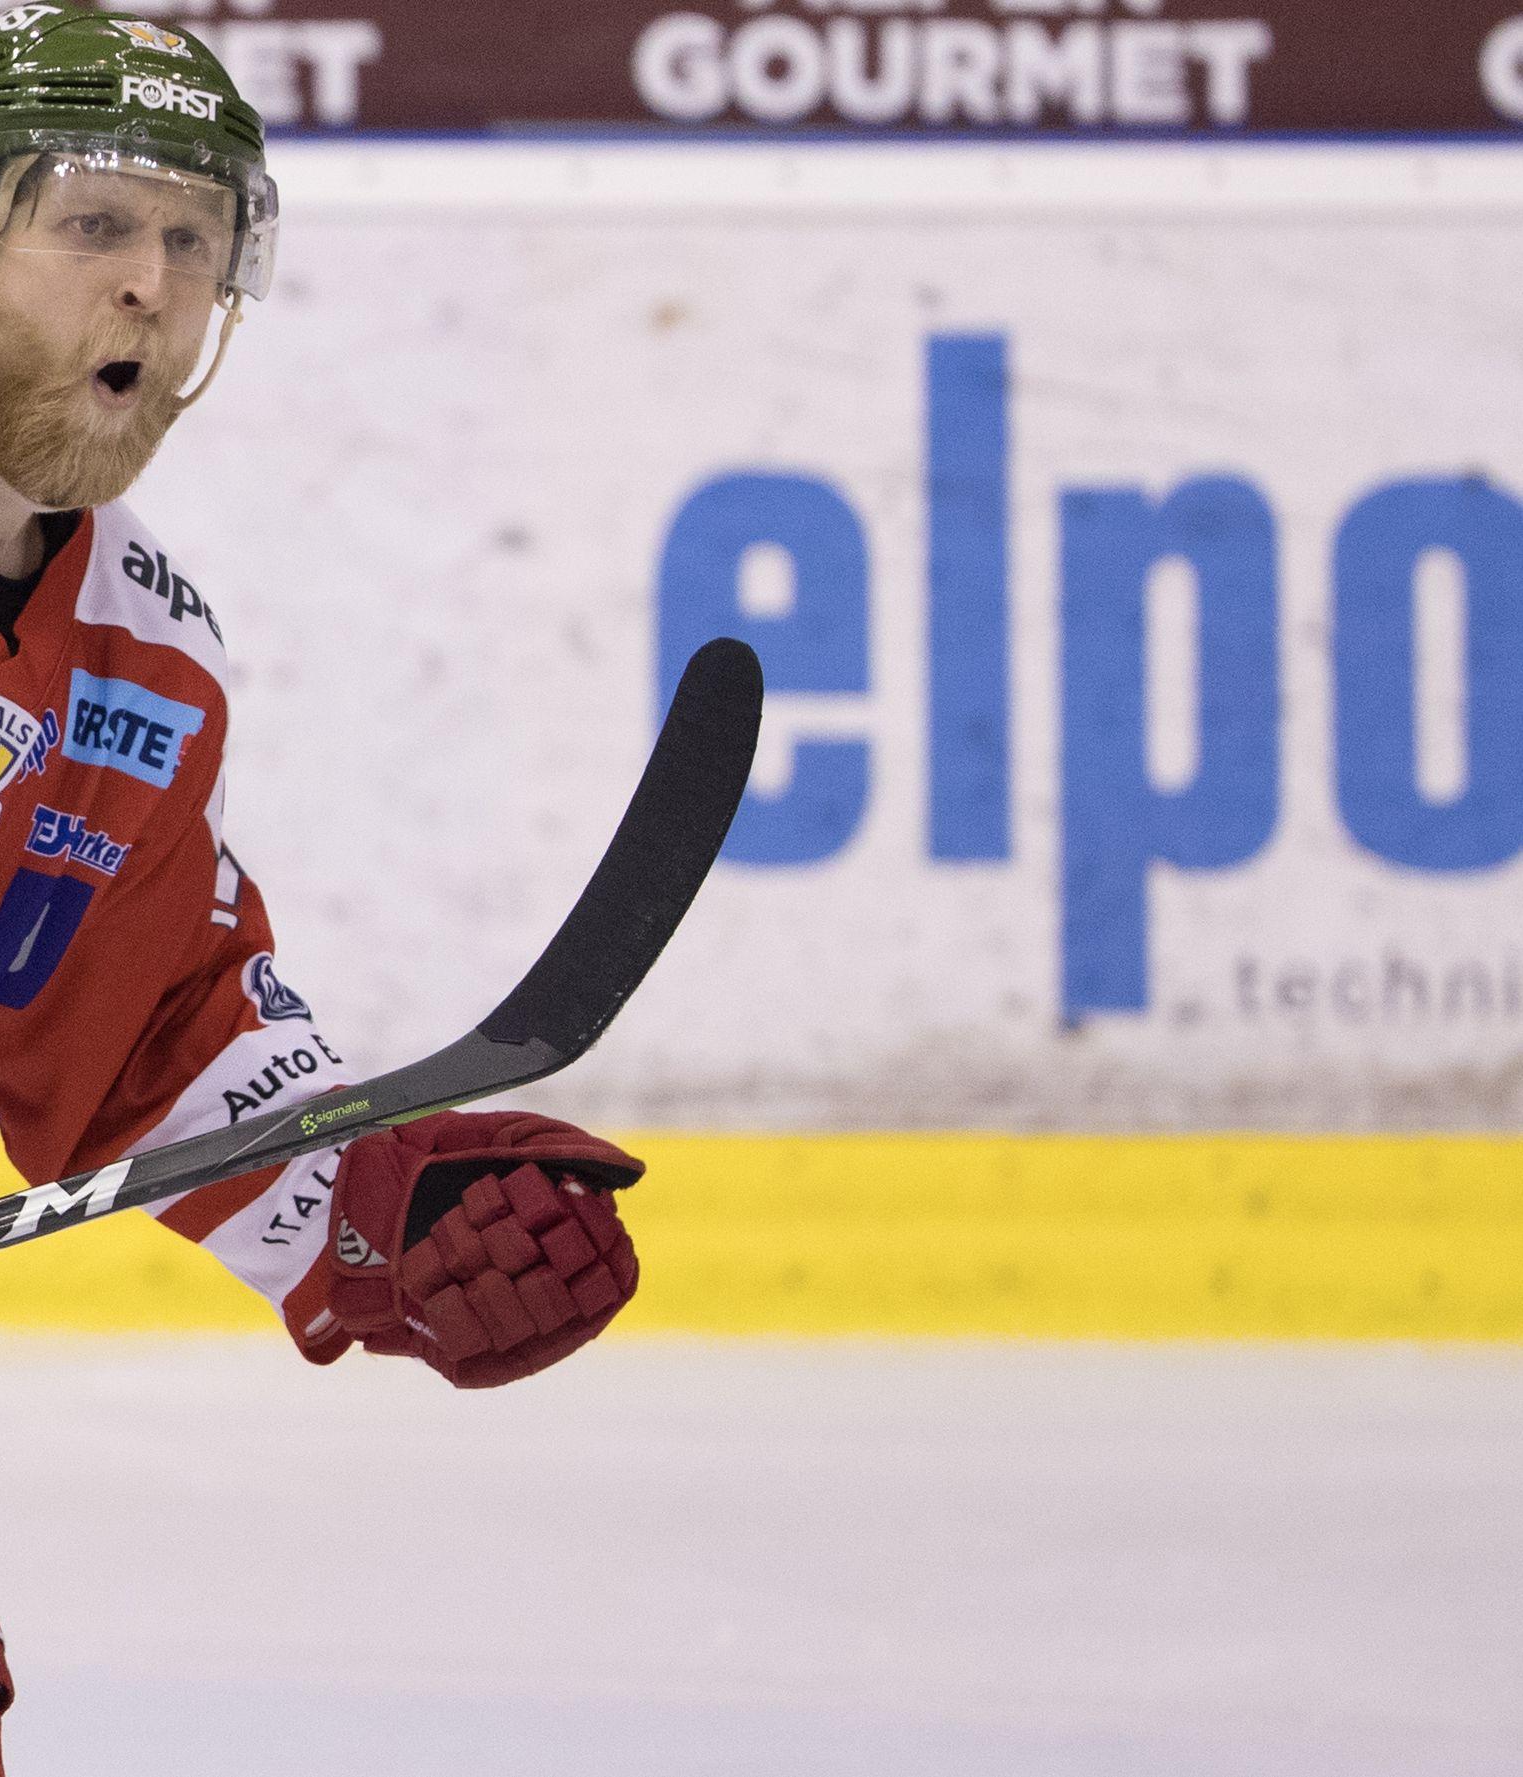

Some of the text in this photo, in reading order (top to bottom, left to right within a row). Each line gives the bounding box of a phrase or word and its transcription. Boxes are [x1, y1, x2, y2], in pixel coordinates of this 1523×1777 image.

[121, 75, 223, 122] FORST
[633, 12, 1270, 124] GOURMET
[653, 330, 1523, 1012] elpo
[72, 698, 175, 770] ERSTE
[221, 1048, 318, 1124] Auto
[314, 1098, 371, 1124] sigmatex
